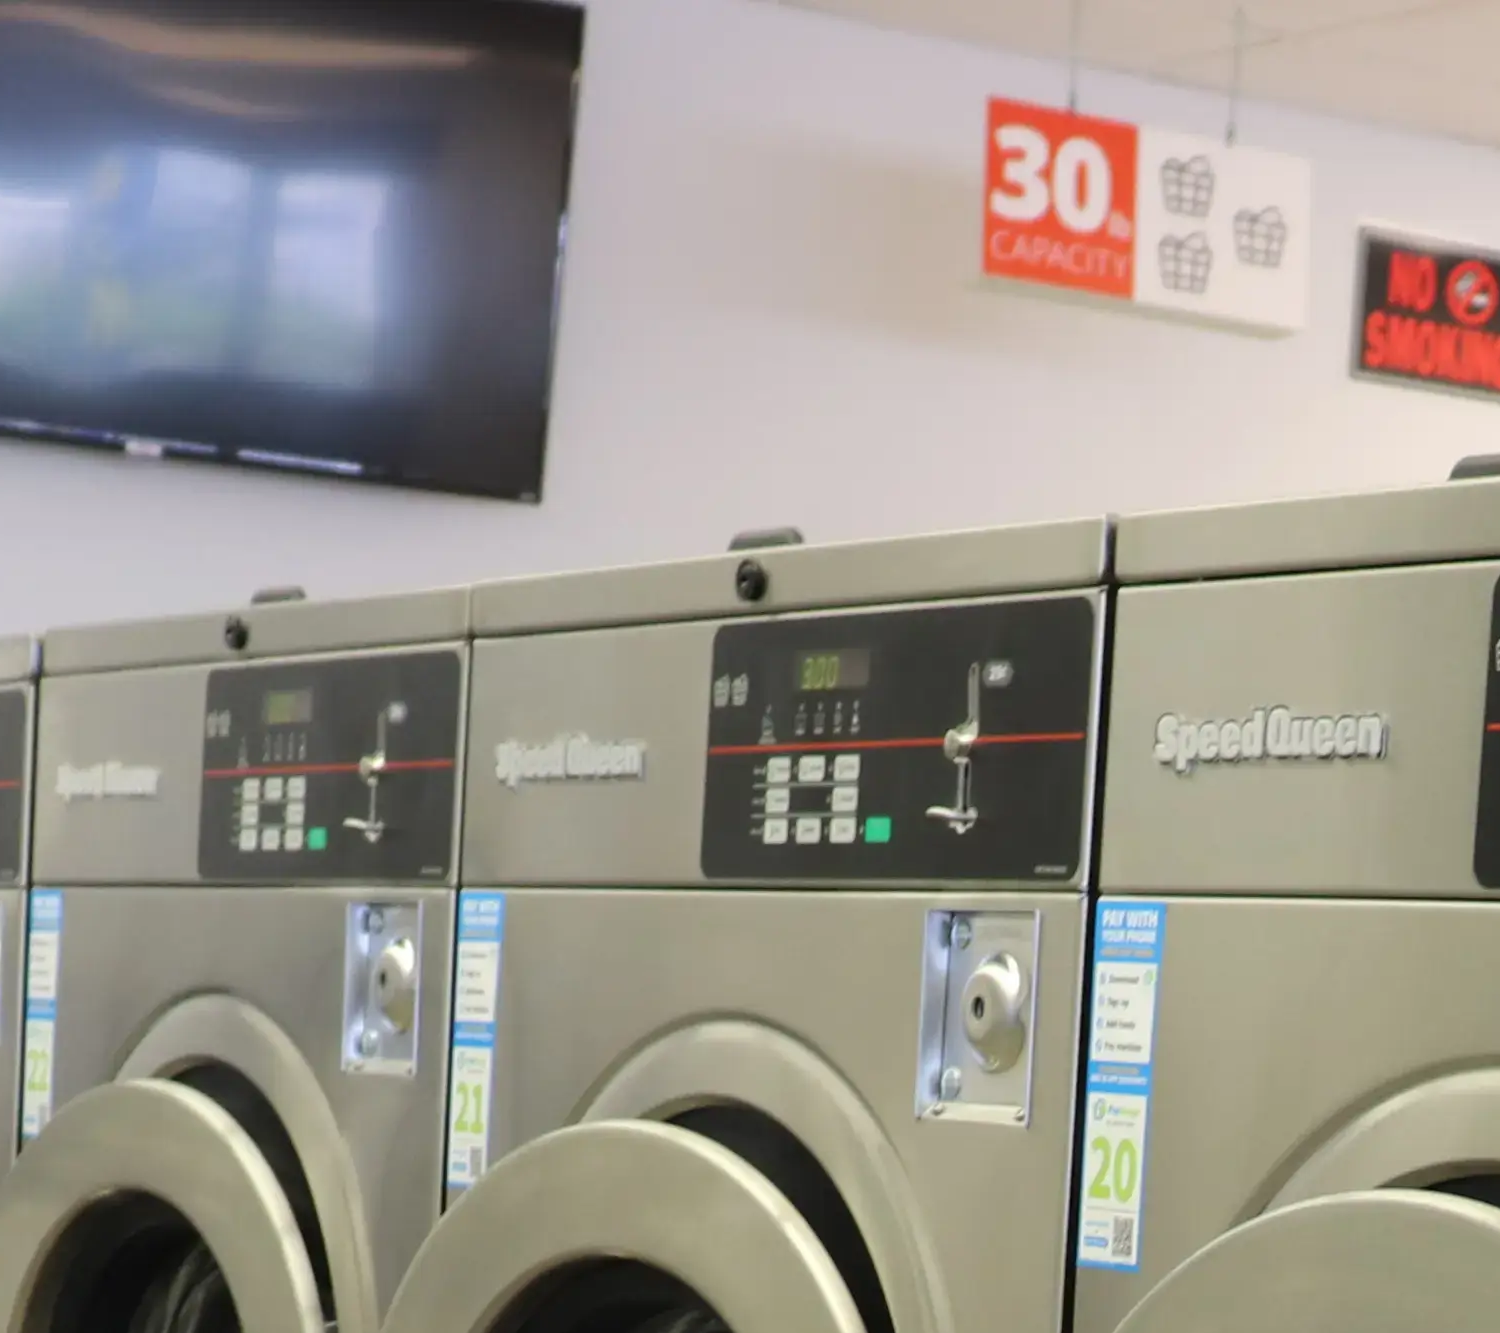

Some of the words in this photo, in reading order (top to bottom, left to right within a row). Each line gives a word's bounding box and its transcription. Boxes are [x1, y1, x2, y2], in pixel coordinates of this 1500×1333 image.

[990, 230, 1129, 279] CAPACITY
[1387, 250, 1437, 312] NO
[454, 1081, 484, 1135] 21
[1088, 1135, 1138, 1204] 20
